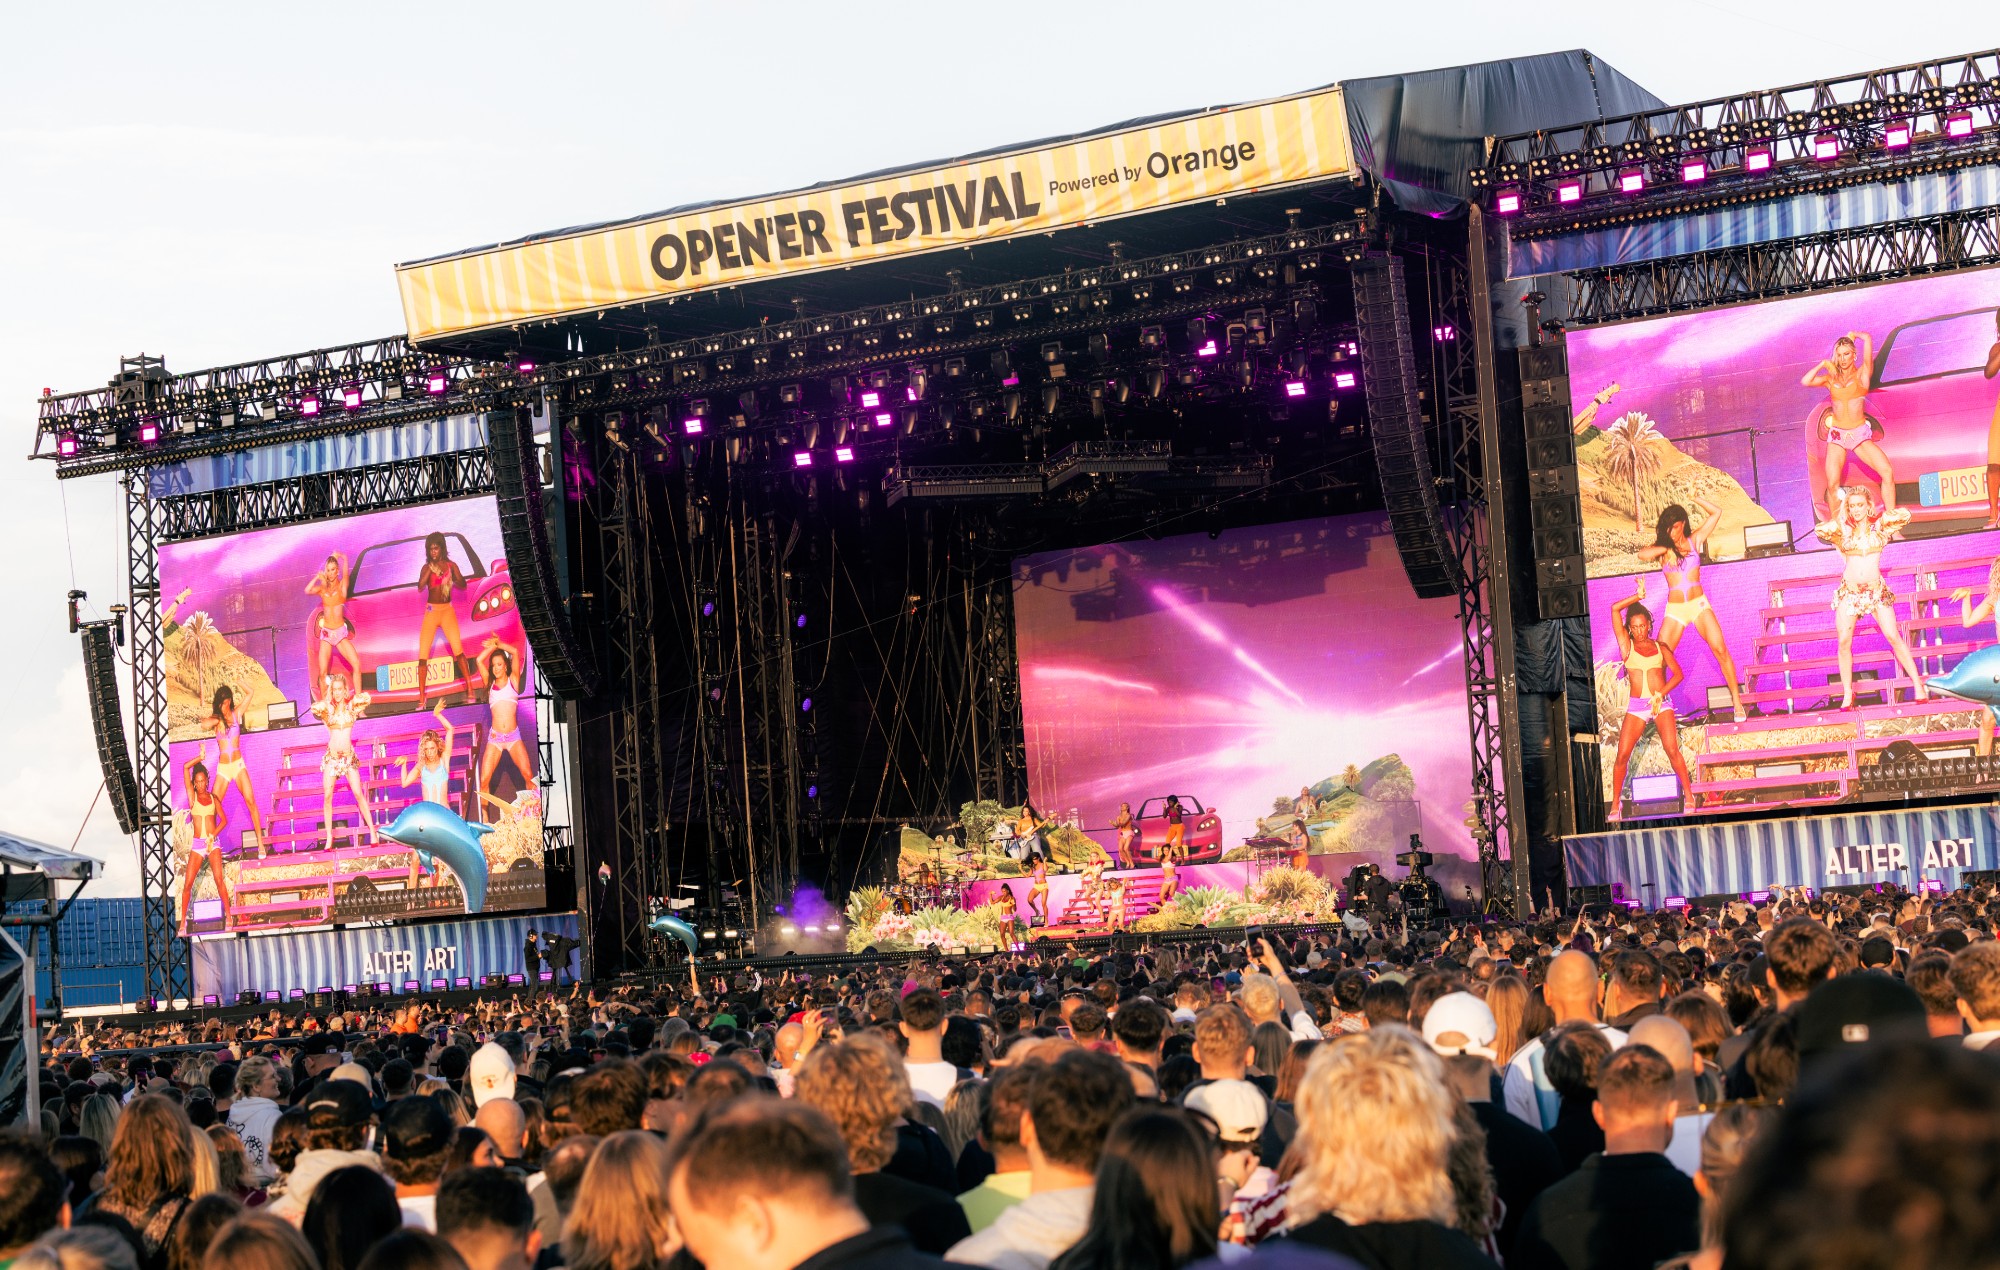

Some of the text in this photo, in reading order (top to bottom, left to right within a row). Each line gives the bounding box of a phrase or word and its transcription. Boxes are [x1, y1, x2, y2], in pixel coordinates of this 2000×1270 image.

[1049, 141, 1256, 195] Powered by Orange
[651, 171, 1040, 281] OPEN'ER FESTIVAL
[1941, 475, 1978, 499] PUSS
[390, 667, 412, 686] PUSS
[440, 661, 452, 679] 97
[1825, 837, 1974, 875] ALTER ART
[363, 946, 456, 975] ALTER ART
